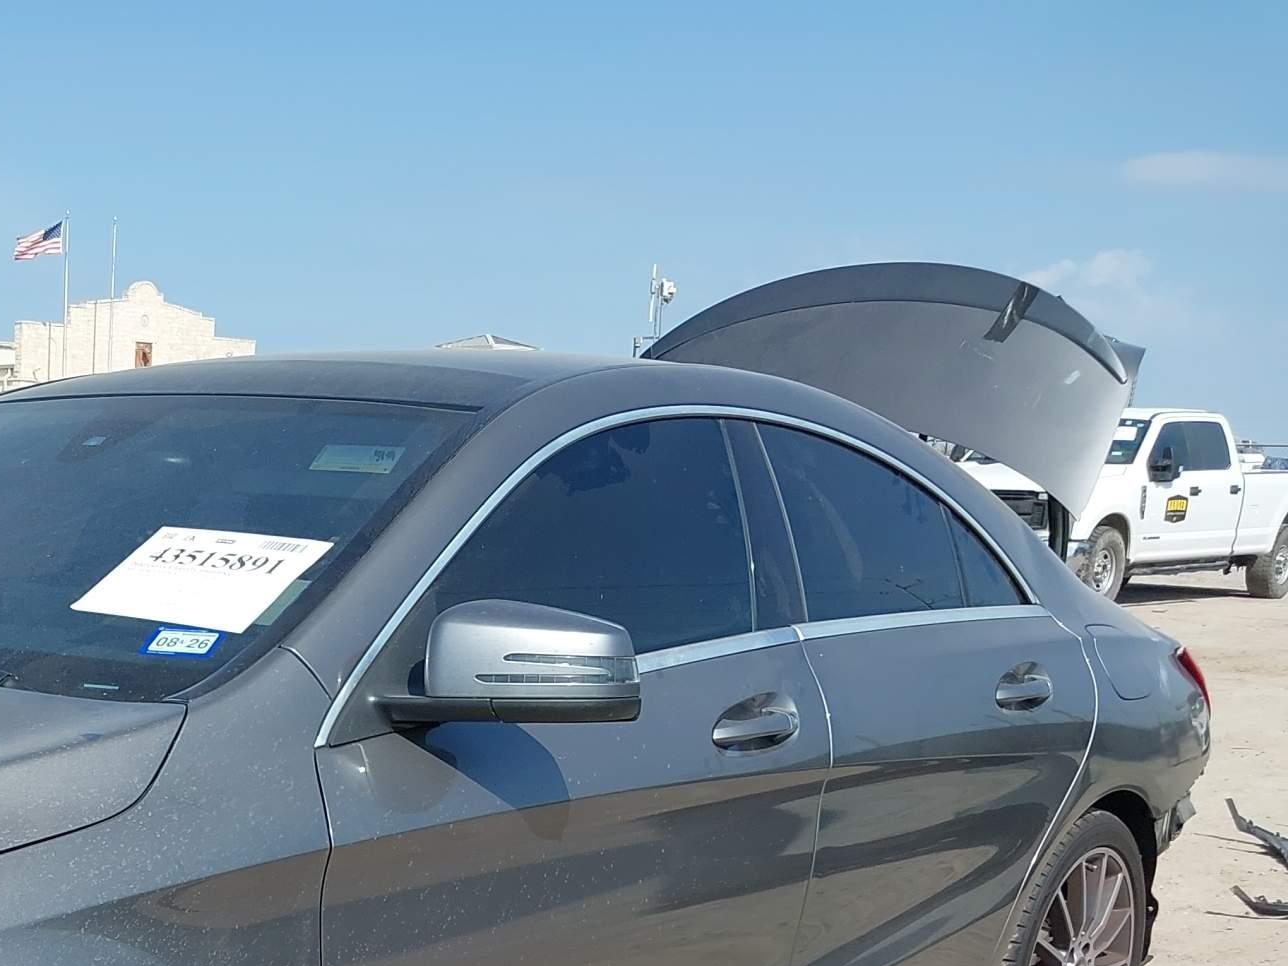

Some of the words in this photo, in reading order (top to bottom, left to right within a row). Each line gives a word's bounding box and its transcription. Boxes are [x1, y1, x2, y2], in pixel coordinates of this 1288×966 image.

[149, 547, 285, 574] 43515891
[156, 636, 179, 648] 08
[186, 638, 211, 649] 26
